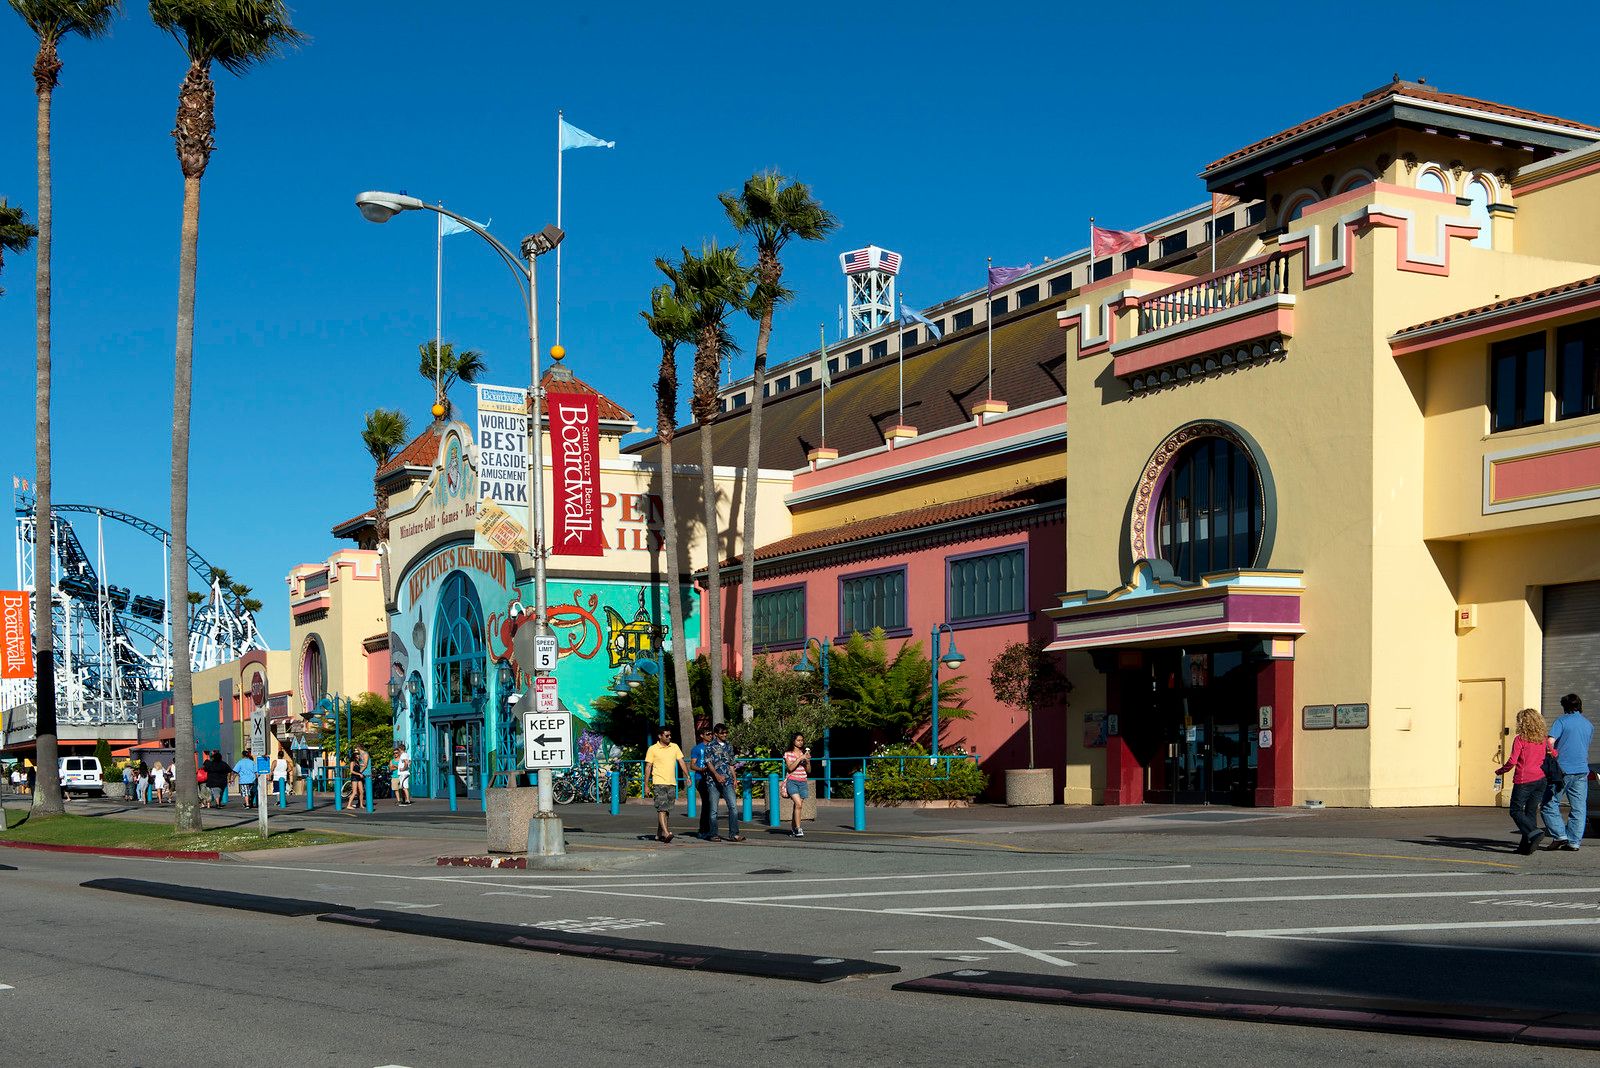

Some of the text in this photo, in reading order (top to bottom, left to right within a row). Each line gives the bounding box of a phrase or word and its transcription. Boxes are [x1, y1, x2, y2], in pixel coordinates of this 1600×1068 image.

[480, 414, 526, 432] WORLD'S
[481, 430, 526, 453] BEST
[481, 451, 527, 469] SEASIDE
[581, 426, 594, 515] Santa Cruz Beach
[480, 468, 527, 481] AMUSEMENT
[558, 403, 593, 545] Boardwalk
[480, 480, 527, 503] PARK
[600, 492, 665, 523] PEN
[399, 503, 476, 540] Miniature Golf Games Res
[600, 528, 666, 551] ILY
[409, 546, 507, 607] NEPTUNE'S KINGDOM
[4, 595, 26, 673] Boardwalk
[542, 655, 550, 666] 5
[530, 719, 565, 730] KEEP
[533, 749, 566, 761] LEFT
